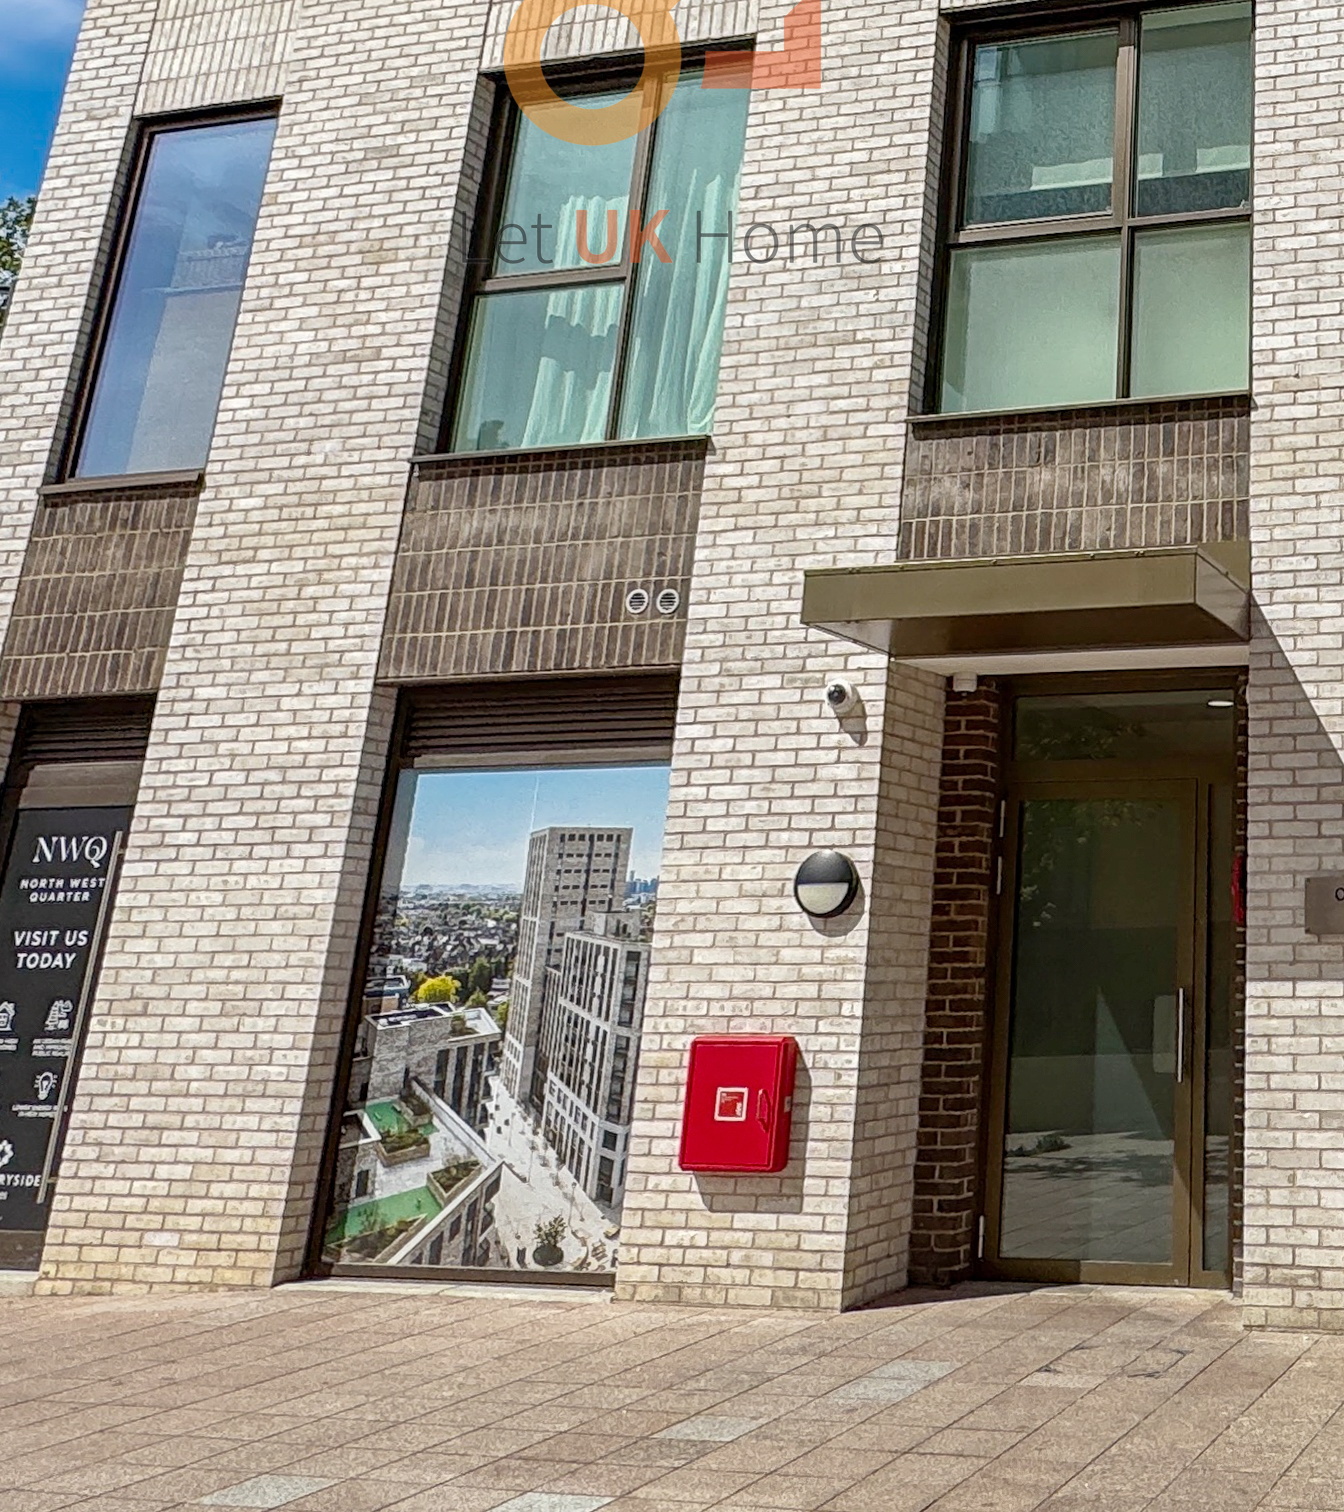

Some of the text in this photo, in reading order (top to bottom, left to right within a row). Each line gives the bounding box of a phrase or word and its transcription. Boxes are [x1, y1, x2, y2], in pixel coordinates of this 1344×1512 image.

[32, 835, 108, 868] NWQ
[19, 877, 106, 889] NORTH WEST
[29, 891, 90, 902] QUARTER
[13, 930, 89, 947] VISIT US
[16, 952, 77, 969] TODAY
